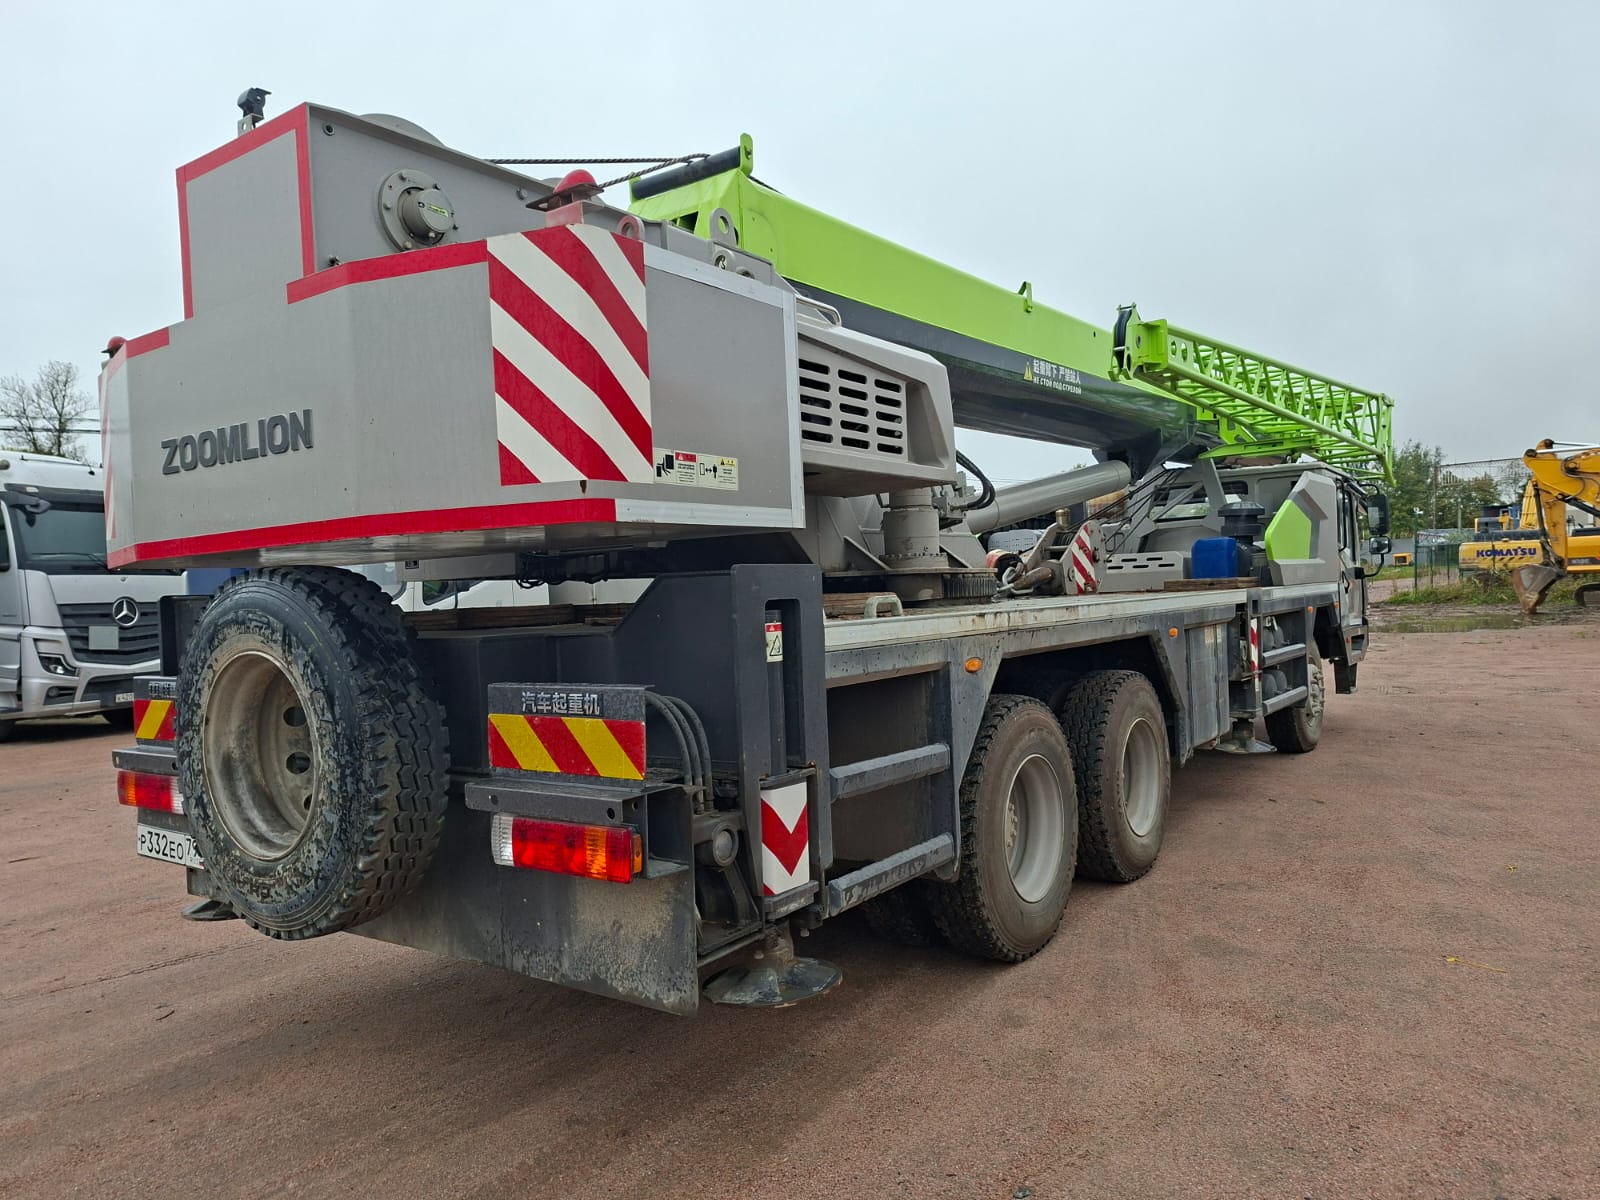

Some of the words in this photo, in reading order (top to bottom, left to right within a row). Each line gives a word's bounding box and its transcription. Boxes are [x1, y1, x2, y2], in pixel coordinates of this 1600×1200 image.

[161, 409, 313, 475] ZOOMLION
[1476, 547, 1537, 558] KOMATSU
[522, 691, 600, 715] 汽车起重机
